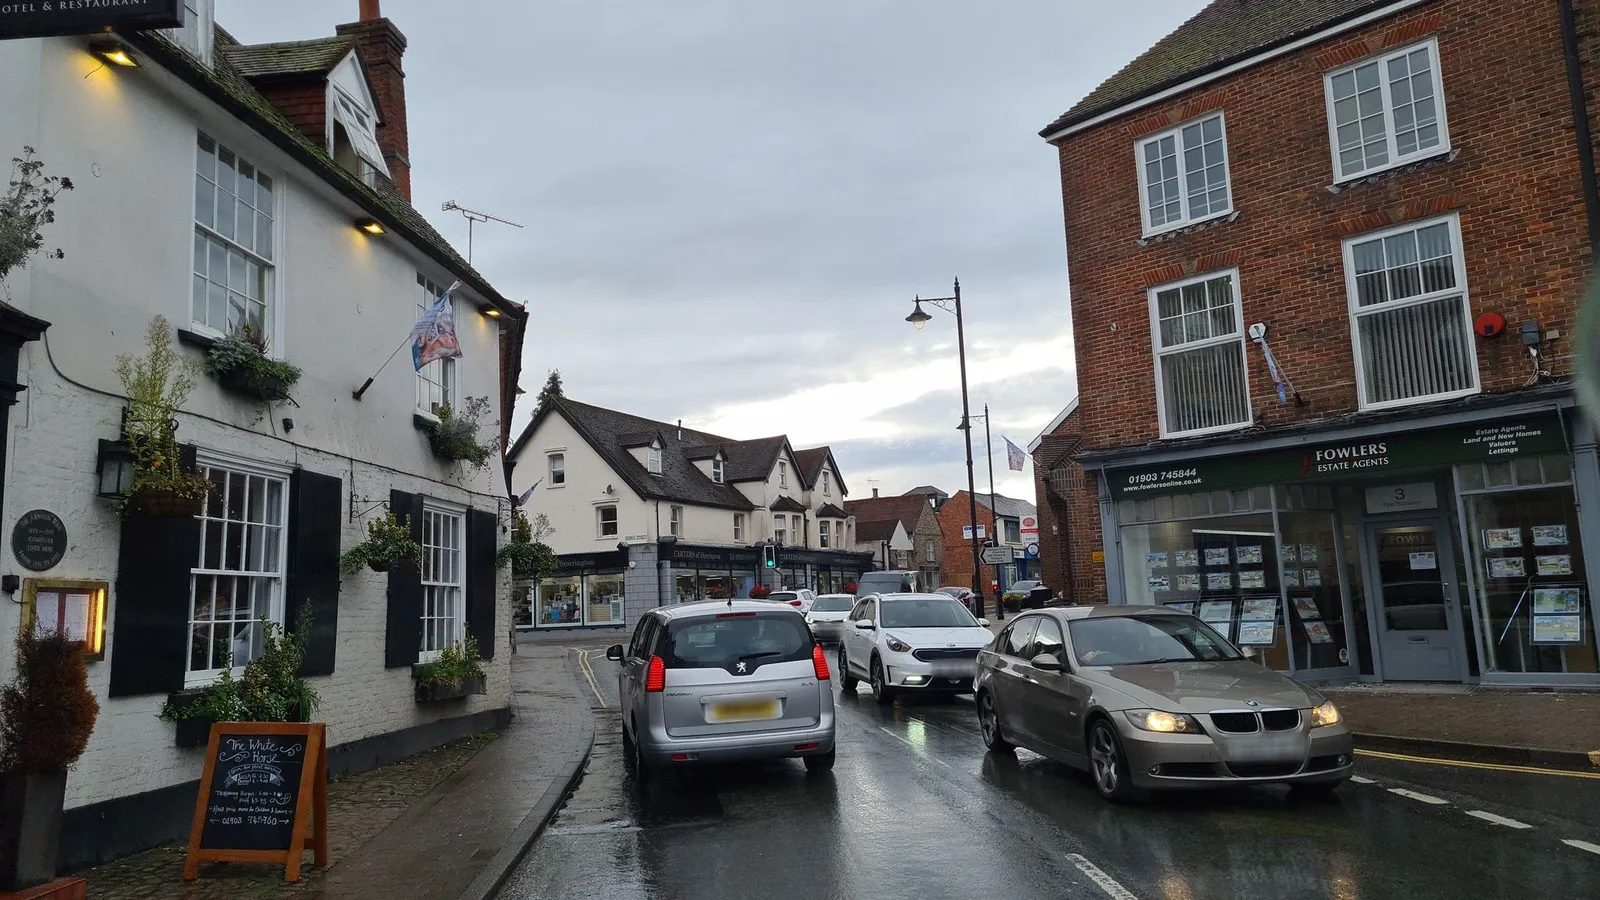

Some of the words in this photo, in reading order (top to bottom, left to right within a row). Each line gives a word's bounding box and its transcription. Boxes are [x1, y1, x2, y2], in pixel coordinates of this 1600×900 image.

[43, 1, 52, 12] &
[1463, 436, 1481, 444] Land
[1497, 431, 1515, 440] New
[1515, 429, 1542, 438] Homes
[1475, 428, 1499, 437] Estate
[1500, 424, 1527, 434] Agents
[1488, 440, 1516, 448] Valuers
[1315, 442, 1388, 461] FOWLERS
[1488, 447, 1519, 455] Lettings
[1317, 461, 1350, 472] ESTATE
[1352, 456, 1389, 469] AGENTS
[1128, 473, 1158, 484] 01903
[1160, 467, 1197, 481] 745844
[1123, 477, 1202, 492] www.fowlersonline.co.uk
[1394, 488, 1405, 501] 3
[558, 560, 595, 569] Storrington
[226, 739, 247, 751] The
[249, 738, 279, 752] White
[252, 751, 282, 764] Horse
[222, 816, 242, 825] 01903
